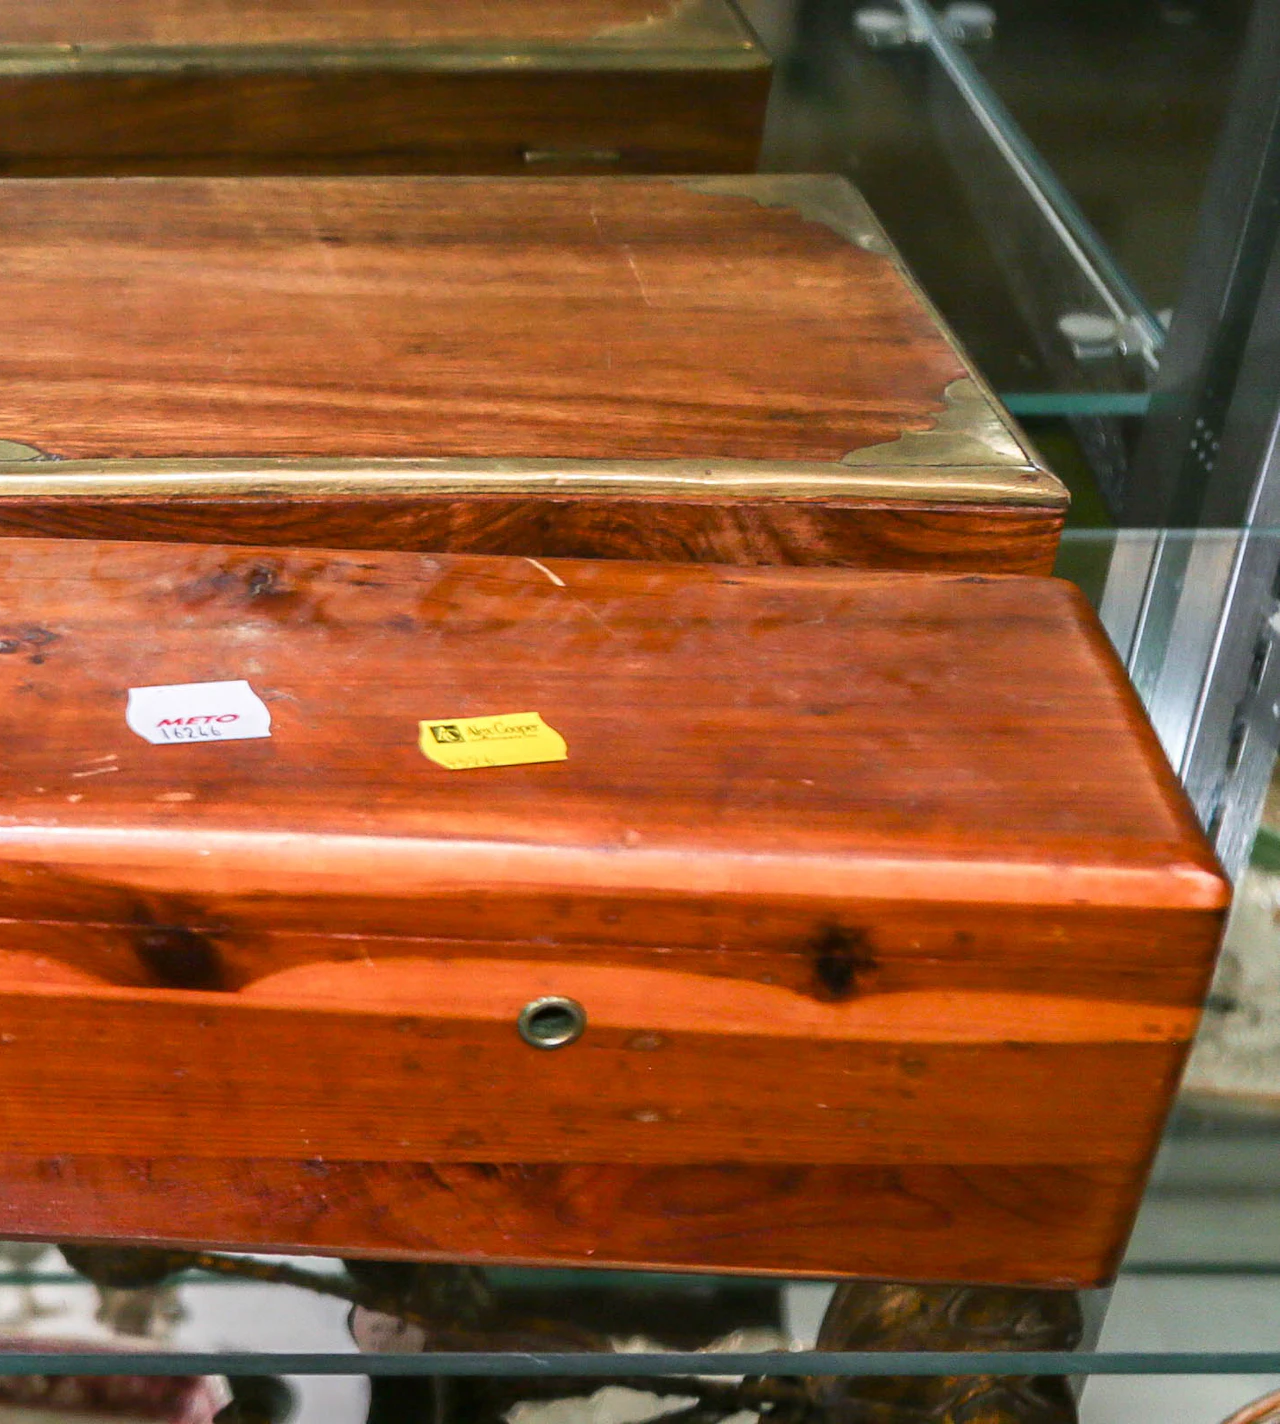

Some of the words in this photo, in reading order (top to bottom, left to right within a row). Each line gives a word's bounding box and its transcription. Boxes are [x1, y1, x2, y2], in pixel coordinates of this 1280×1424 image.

[157, 713, 241, 728] METO
[161, 725, 222, 740] 16246
[467, 725, 492, 737] Alex
[493, 721, 539, 737] Cooper
